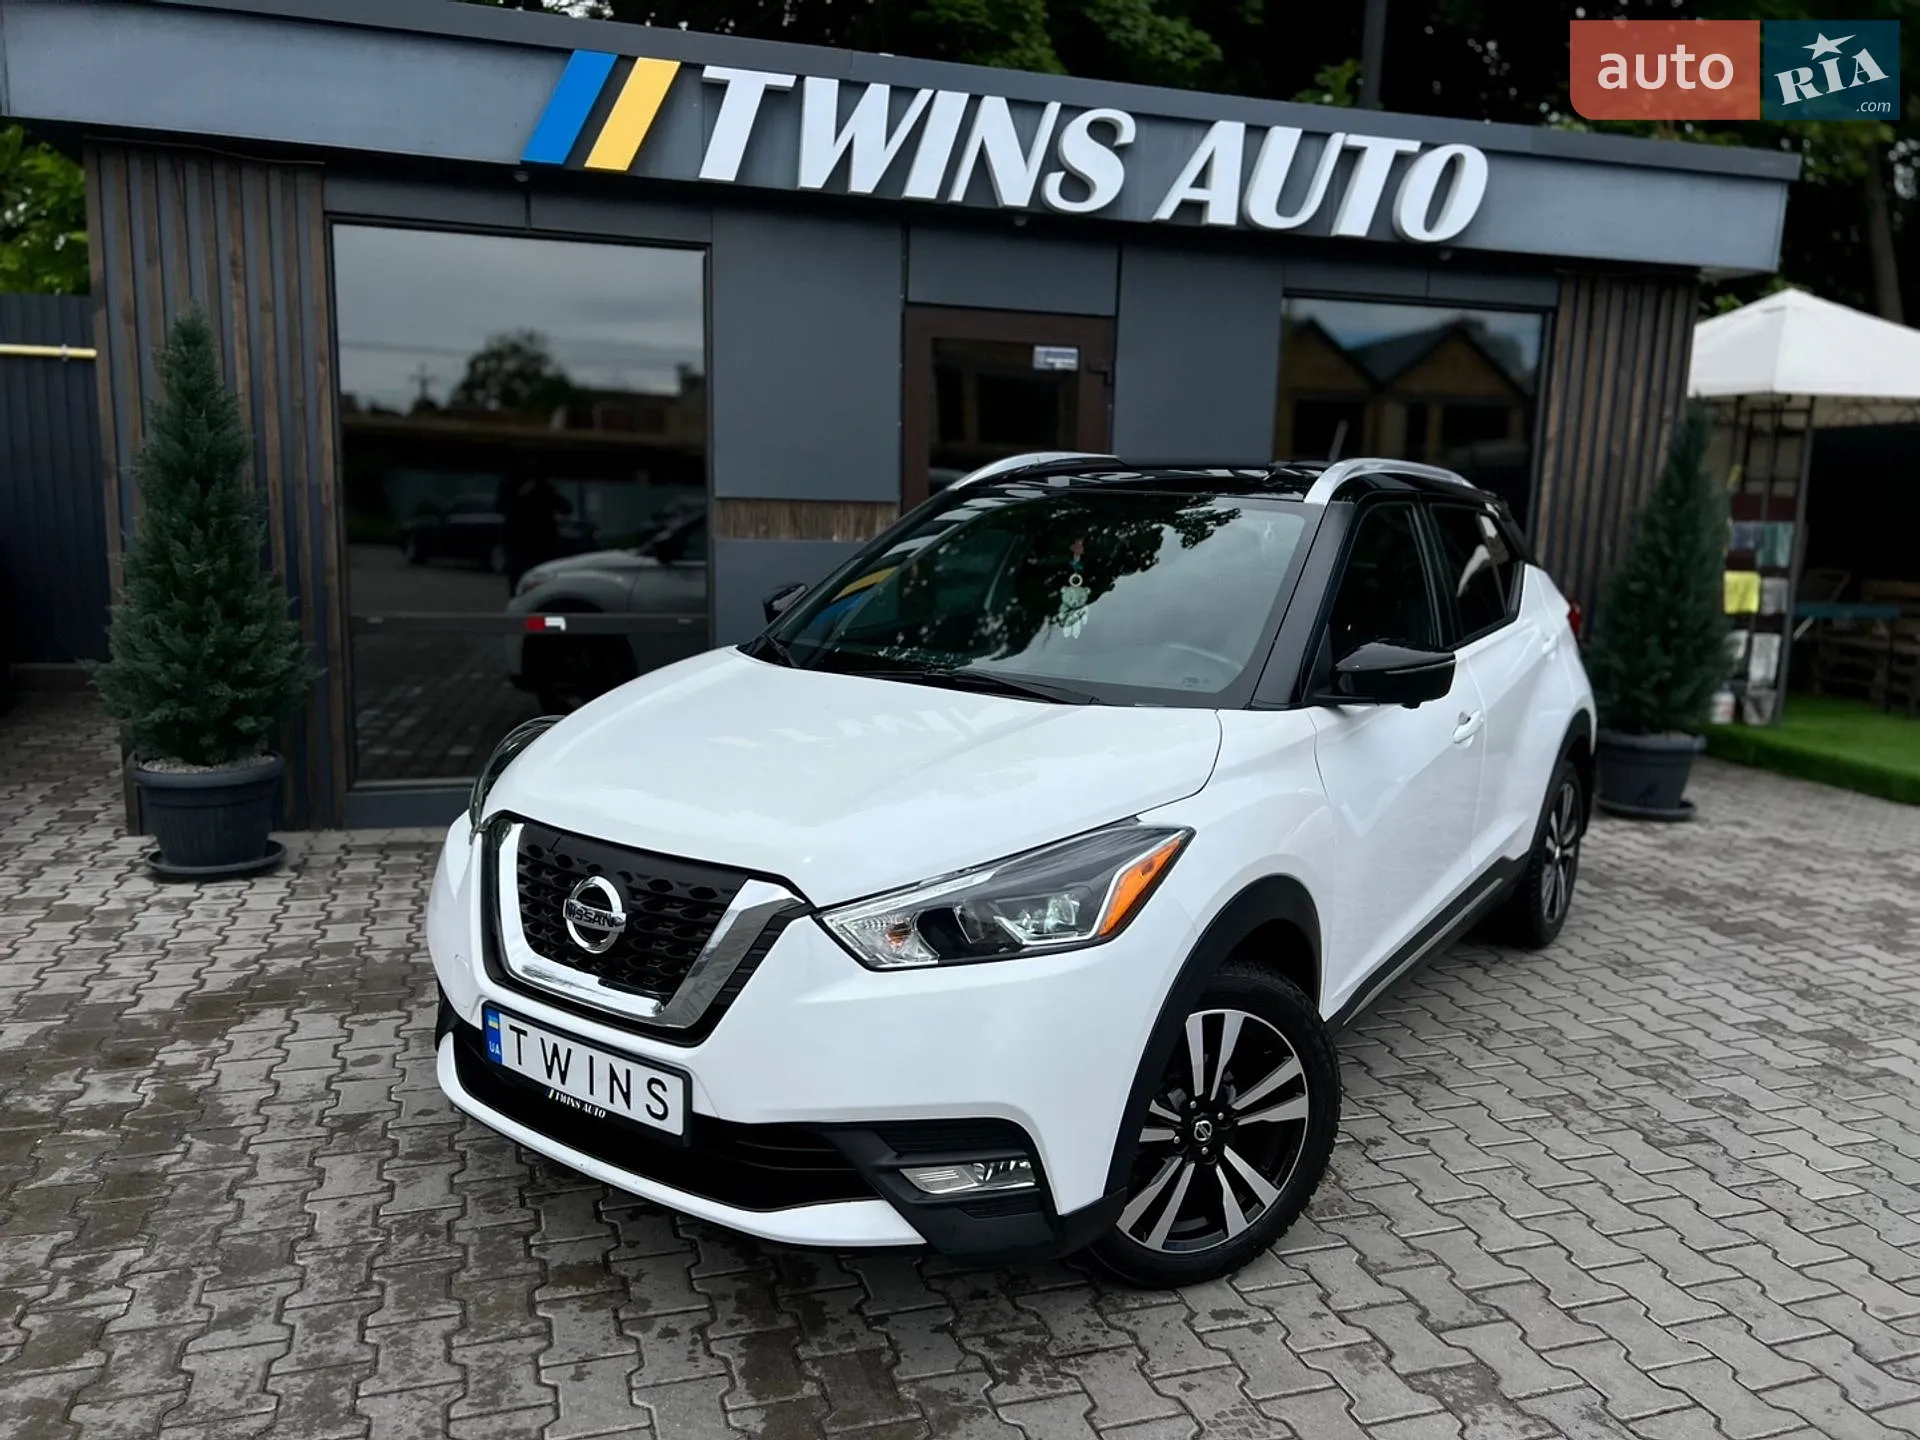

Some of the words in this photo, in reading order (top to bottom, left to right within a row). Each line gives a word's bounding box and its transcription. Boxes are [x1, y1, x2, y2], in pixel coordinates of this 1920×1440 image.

[697, 64, 1136, 214] TWINS
[1153, 119, 1490, 243] AUTO
[565, 901, 621, 928] NISSAN
[488, 1043, 500, 1055] UA
[508, 1025, 669, 1121] TWINS
[554, 1091, 581, 1109] TWINS
[582, 1103, 606, 1119] AUTO
